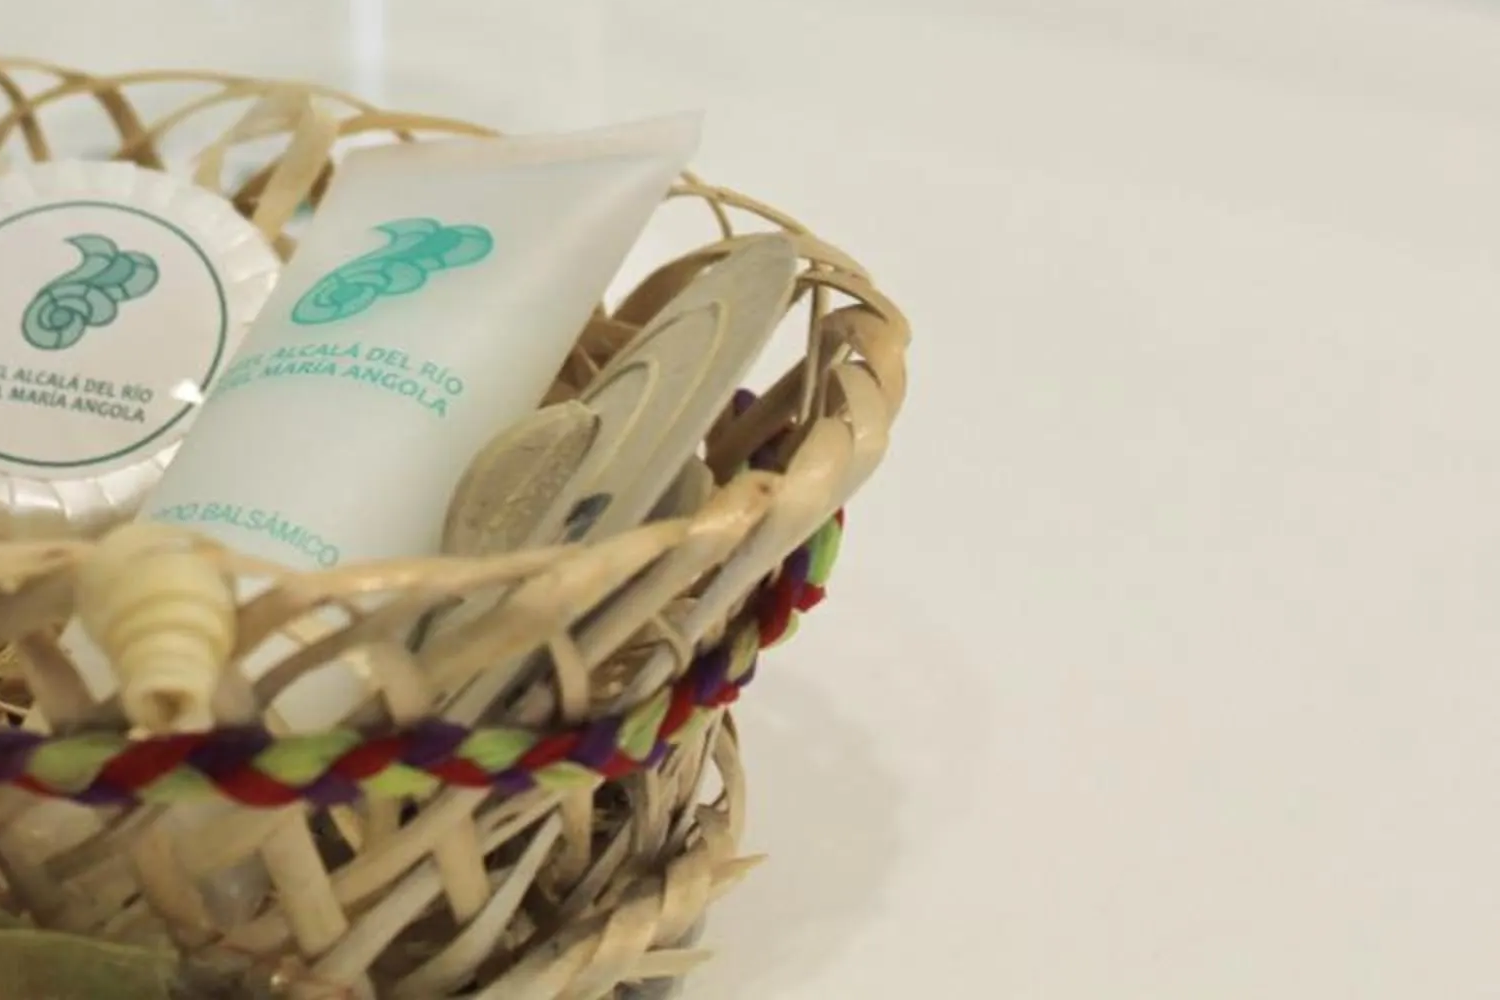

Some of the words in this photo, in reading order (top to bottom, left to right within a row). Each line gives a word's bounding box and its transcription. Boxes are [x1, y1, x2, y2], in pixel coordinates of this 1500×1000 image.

[12, 367, 81, 393] ALCALÁ
[83, 377, 117, 398] DEL
[120, 381, 155, 405] RÍO
[341, 363, 450, 419] ANGOLA
[365, 346, 412, 371] DEL
[419, 360, 464, 396] RÍO
[8, 386, 68, 409] MARÍA
[70, 396, 146, 424] ANGOLA
[200, 502, 340, 568] BALSÁMICO
